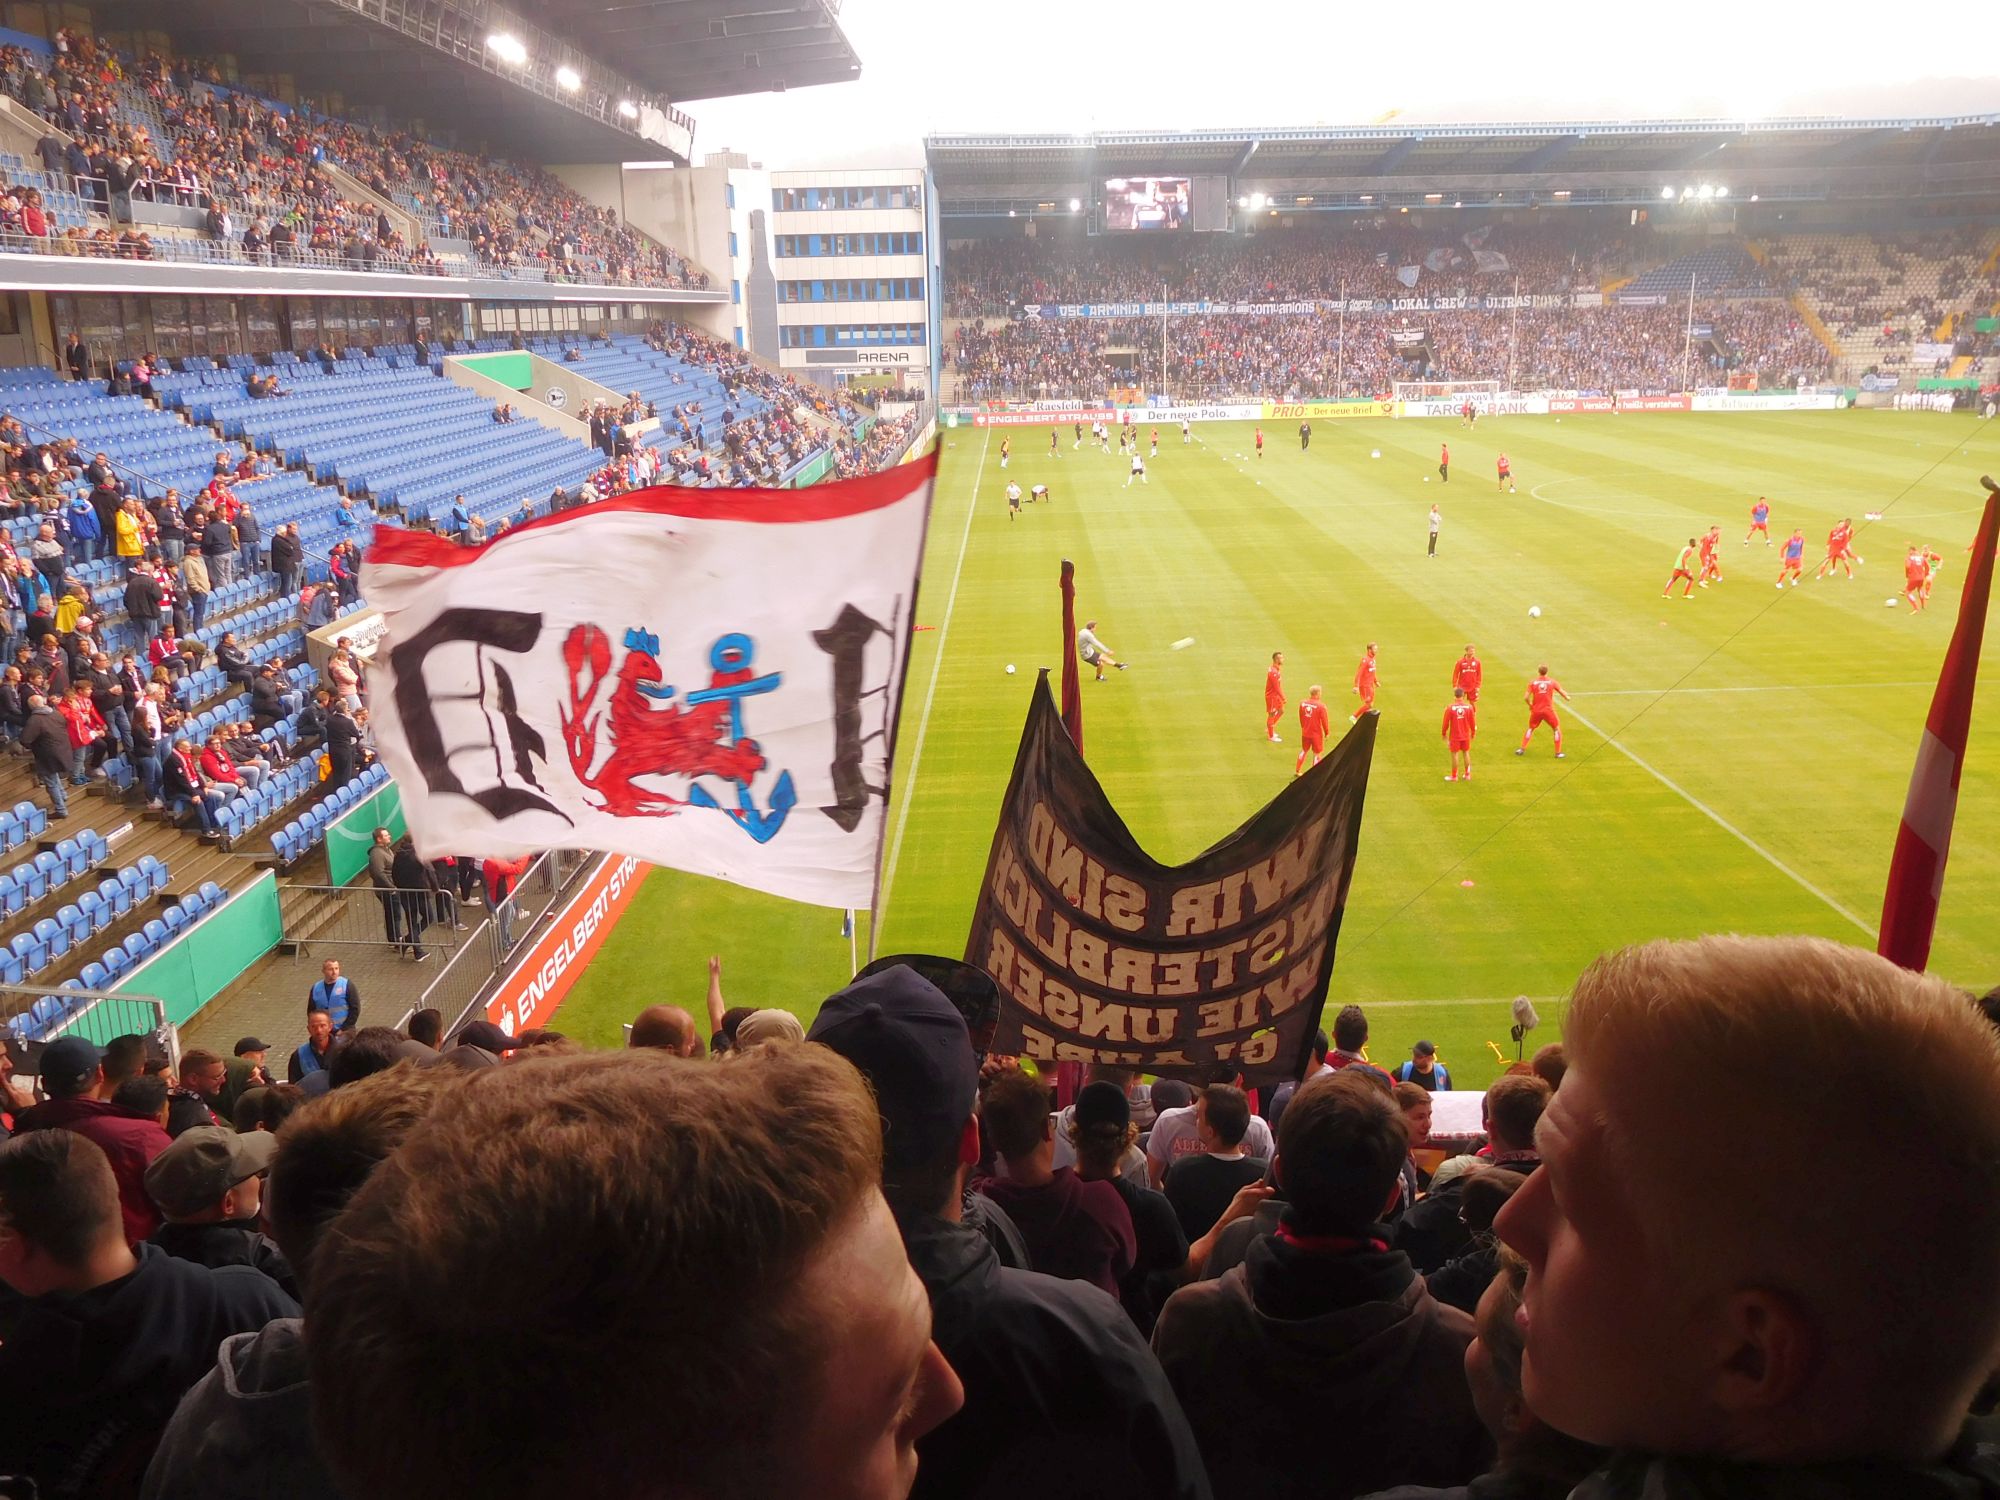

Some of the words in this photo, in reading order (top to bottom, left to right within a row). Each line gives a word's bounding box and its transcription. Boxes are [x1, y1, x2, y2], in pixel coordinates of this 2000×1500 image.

[1392, 299, 1430, 311] LOKAL
[1434, 297, 1467, 310] CREW
[1486, 296, 1531, 308] ULTRAS
[1059, 304, 1085, 317] DSC
[1089, 303, 1140, 316] ARMINIA
[1144, 302, 1213, 315] BIELEFELD
[858, 352, 909, 362] ARENA
[1036, 401, 1081, 412] Raesfeld
[1314, 408, 1328, 416] Der
[1331, 407, 1350, 415] neue
[1354, 406, 1372, 415] Brief
[1552, 402, 1576, 410] ERGO
[988, 414, 1057, 424] ENGELBERT
[1059, 412, 1114, 421] STRAUSS
[1148, 411, 1166, 420] Der
[1201, 409, 1230, 418] Polo.
[517, 885, 609, 1026] ENGELBERT
